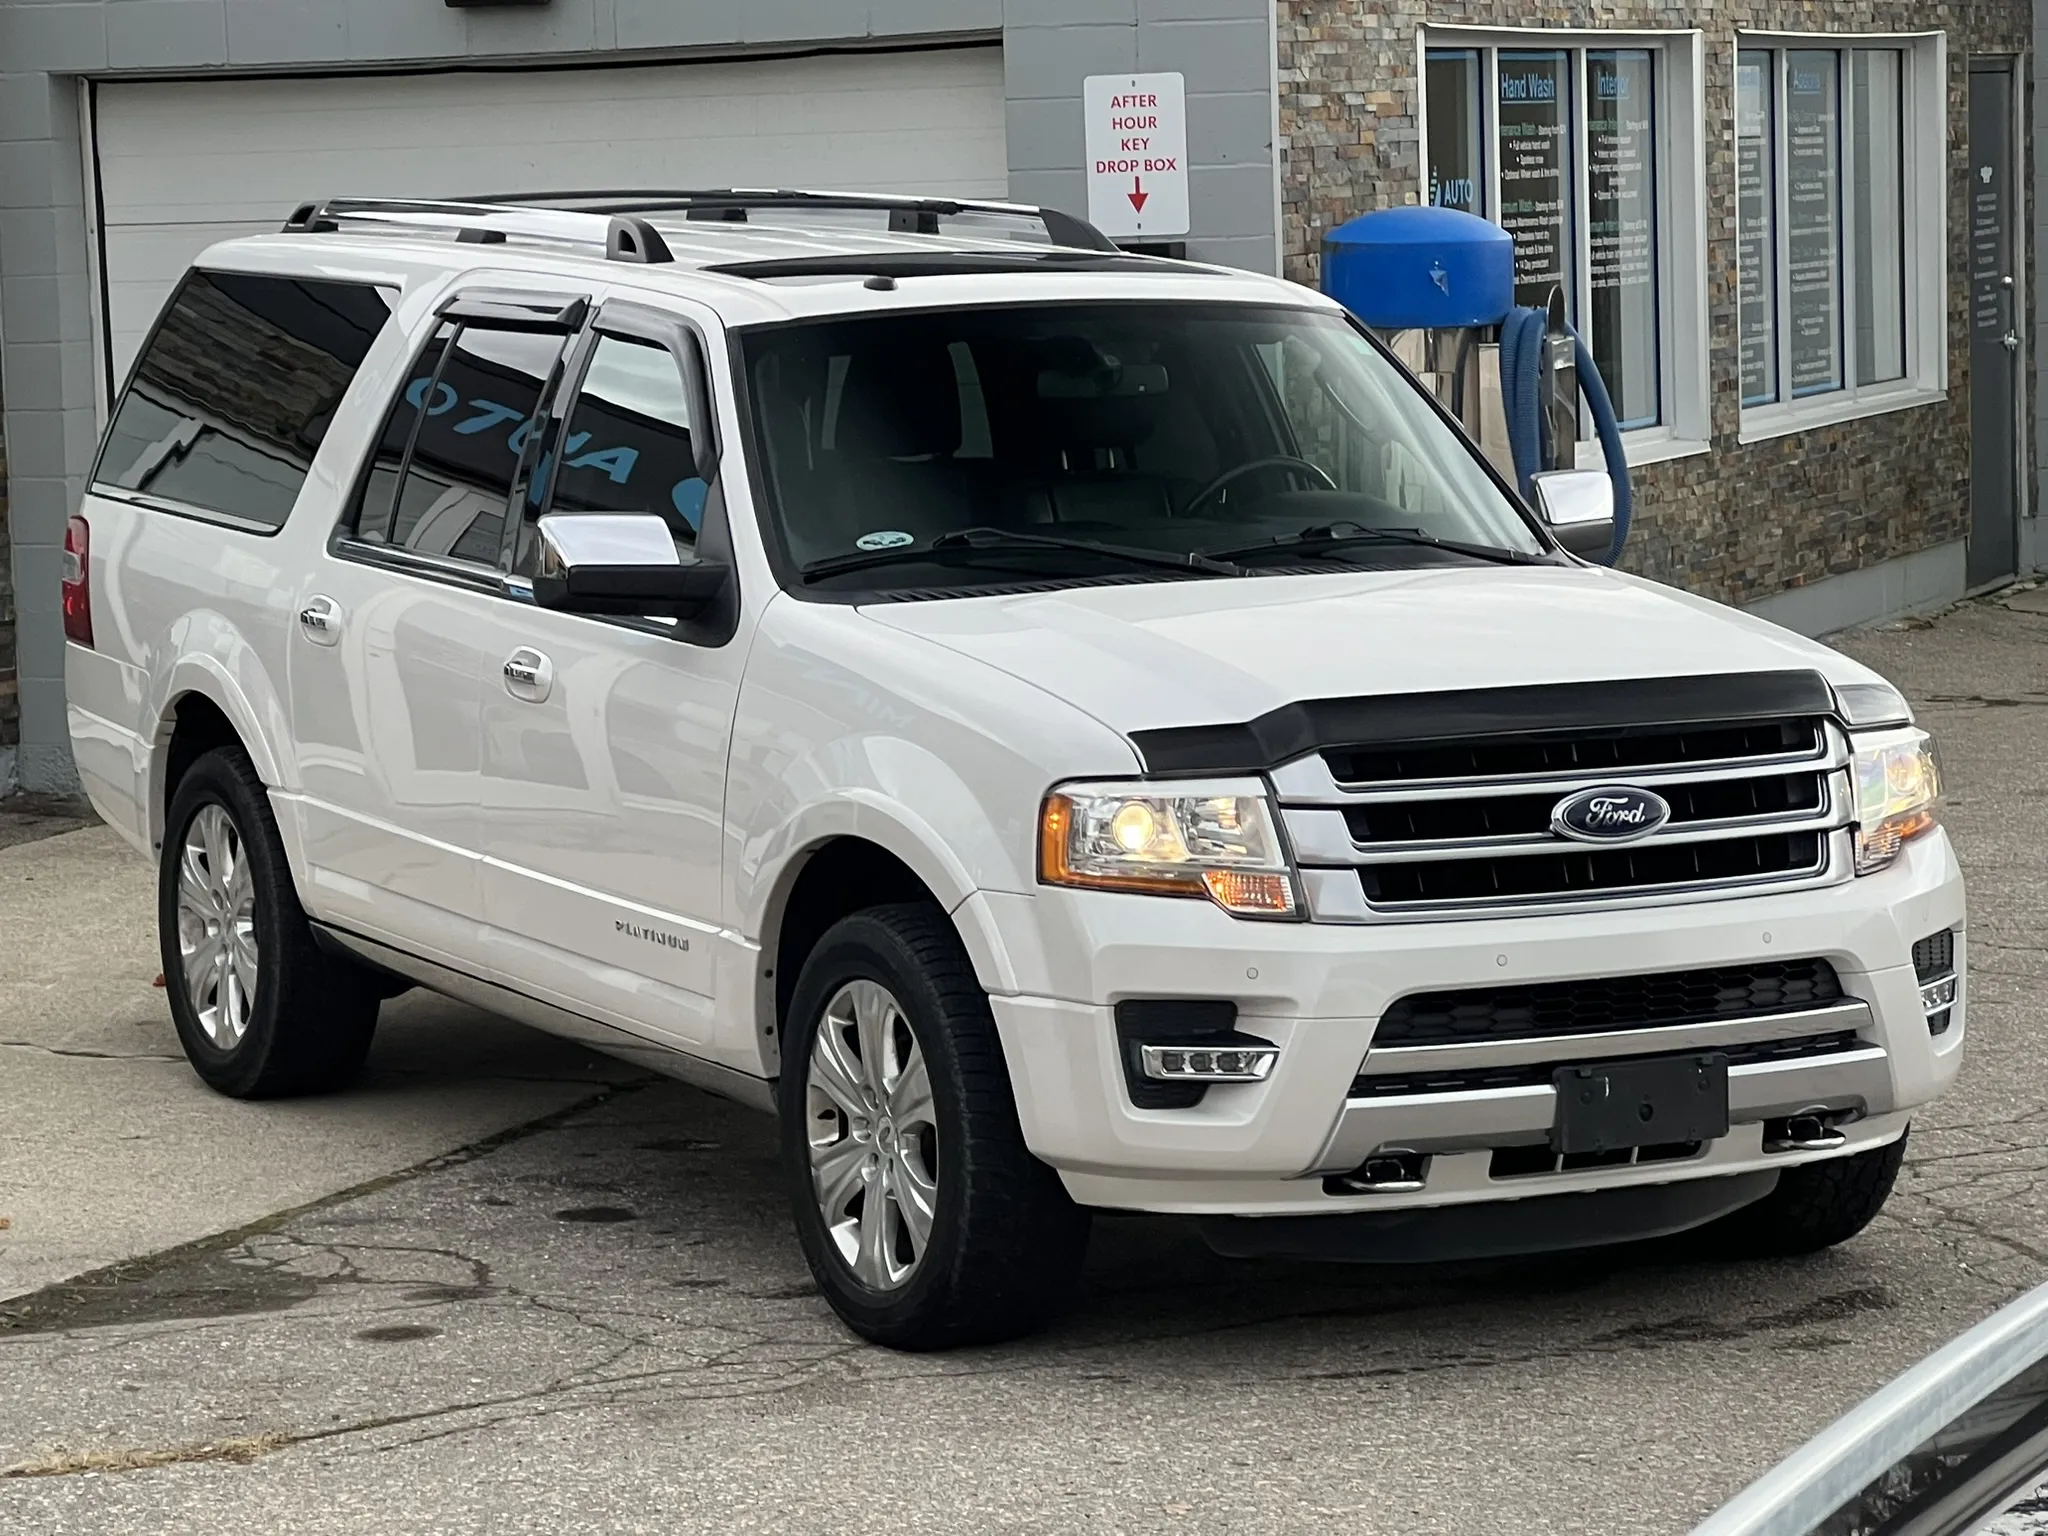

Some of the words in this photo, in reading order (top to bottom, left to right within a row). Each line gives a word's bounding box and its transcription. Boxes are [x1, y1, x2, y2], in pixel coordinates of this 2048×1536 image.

[1501, 73, 1526, 98] Hand
[1528, 73, 1555, 98] Wash
[1111, 95, 1157, 108] AFTER
[1112, 116, 1157, 129] HOUR
[1121, 138, 1149, 151] KEY
[1096, 160, 1139, 173] DROP
[1144, 158, 1177, 171] BOX
[1444, 179, 1474, 205] AUTO
[1585, 797, 1646, 828] Ford
[615, 919, 690, 952] PLATINUM
